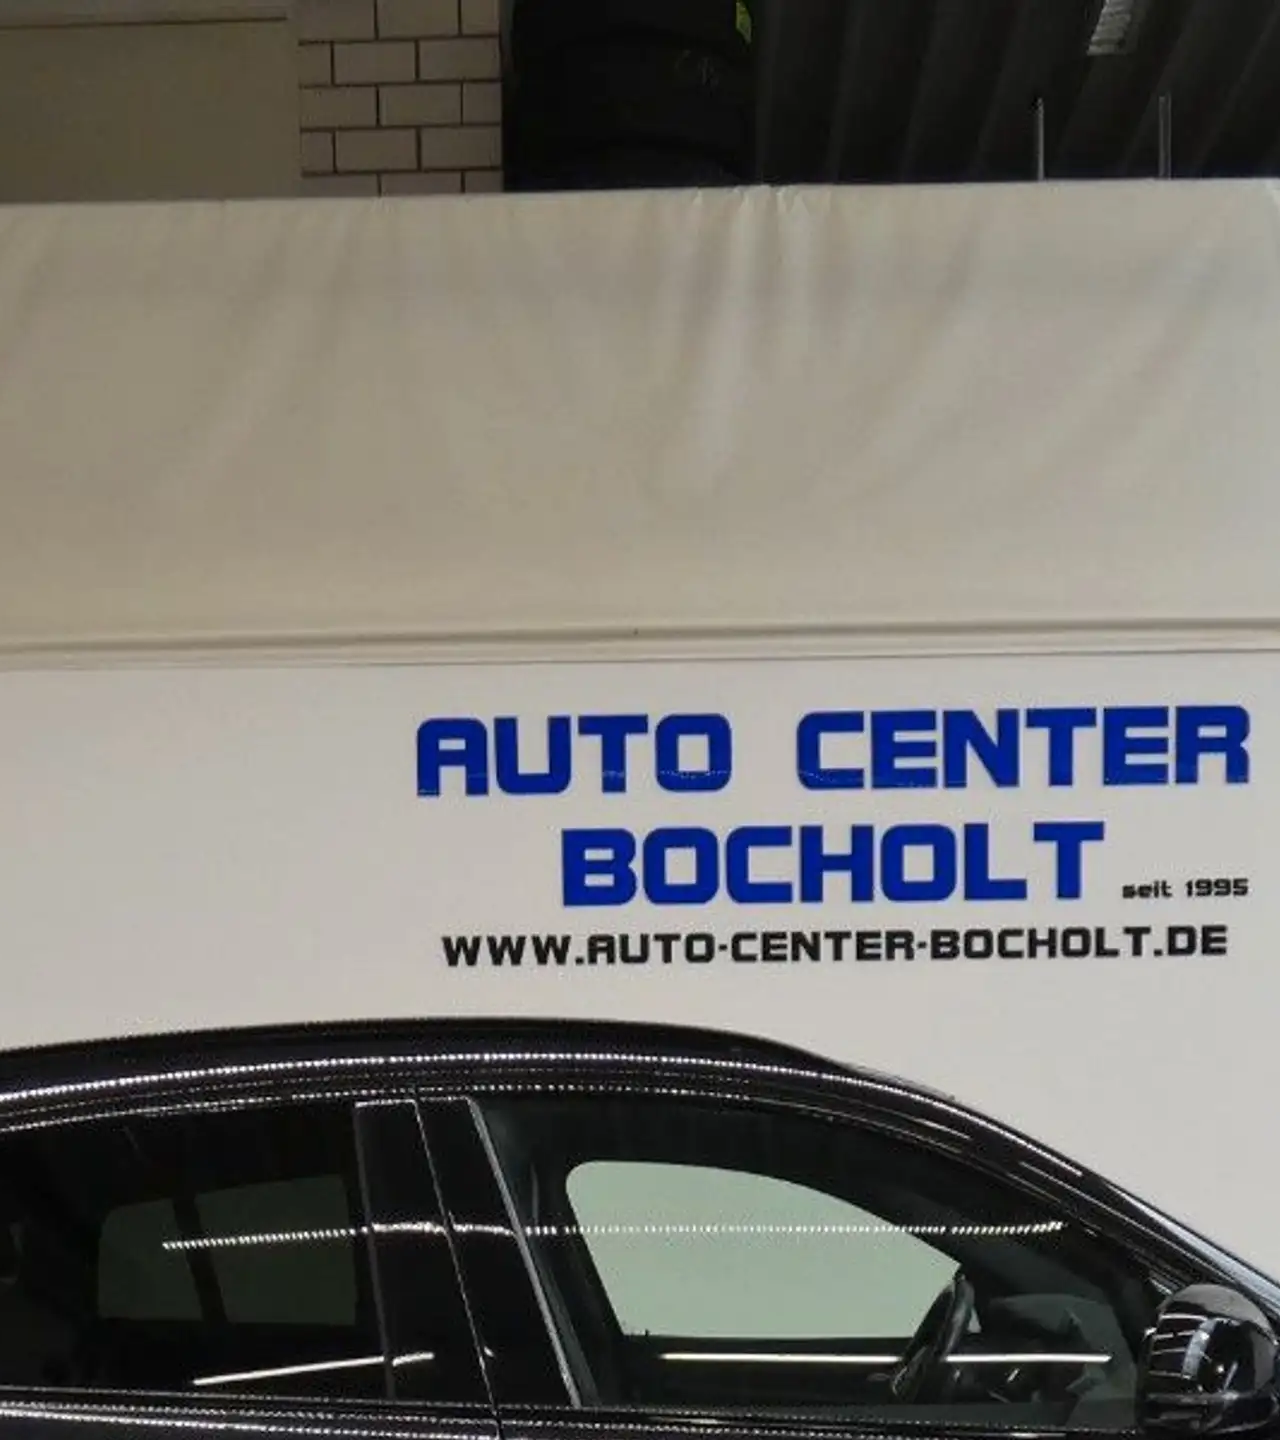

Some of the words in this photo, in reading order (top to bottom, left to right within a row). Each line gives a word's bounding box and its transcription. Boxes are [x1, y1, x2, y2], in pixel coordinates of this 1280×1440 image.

[417, 713, 734, 798] AUTO
[796, 704, 1251, 791] CENTER
[561, 821, 1106, 909] BOCHOLT
[1122, 879, 1174, 899] seit
[1184, 878, 1250, 898] 1995
[441, 924, 1228, 967] WWW.AUTO-CENTER-BOCHOLT.DE
